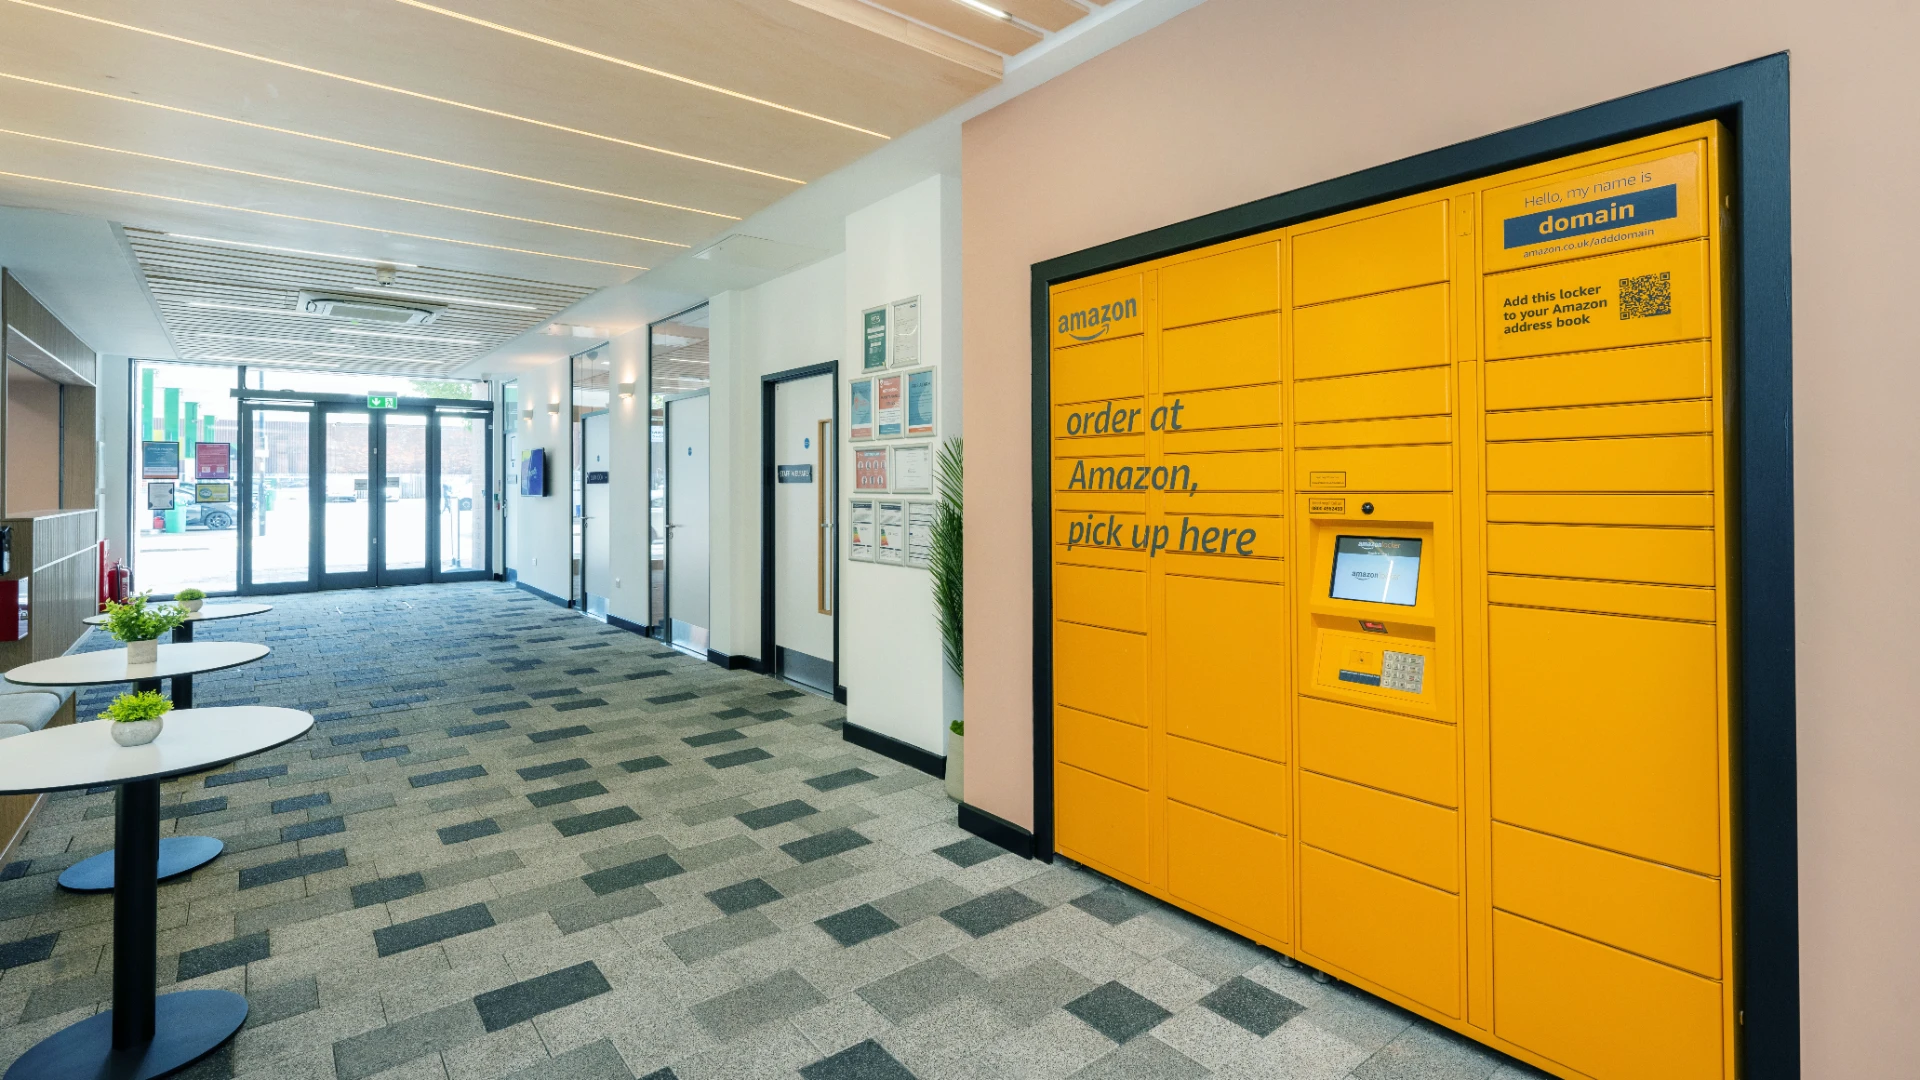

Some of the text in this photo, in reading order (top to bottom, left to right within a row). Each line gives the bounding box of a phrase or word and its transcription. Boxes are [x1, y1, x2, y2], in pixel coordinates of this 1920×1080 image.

[1524, 171, 1652, 209] Hello, my name is
[1538, 201, 1635, 236] domain
[1523, 227, 1655, 259] amazon.co.uk/adddomain
[1503, 285, 1602, 308] Add this locker
[1503, 298, 1608, 322] to your Amazon
[1058, 297, 1138, 335] amazon
[1503, 314, 1591, 335] address book
[1066, 399, 1185, 436] order at
[1068, 459, 1199, 498] Amazon,
[1067, 514, 1257, 558] pick up here
